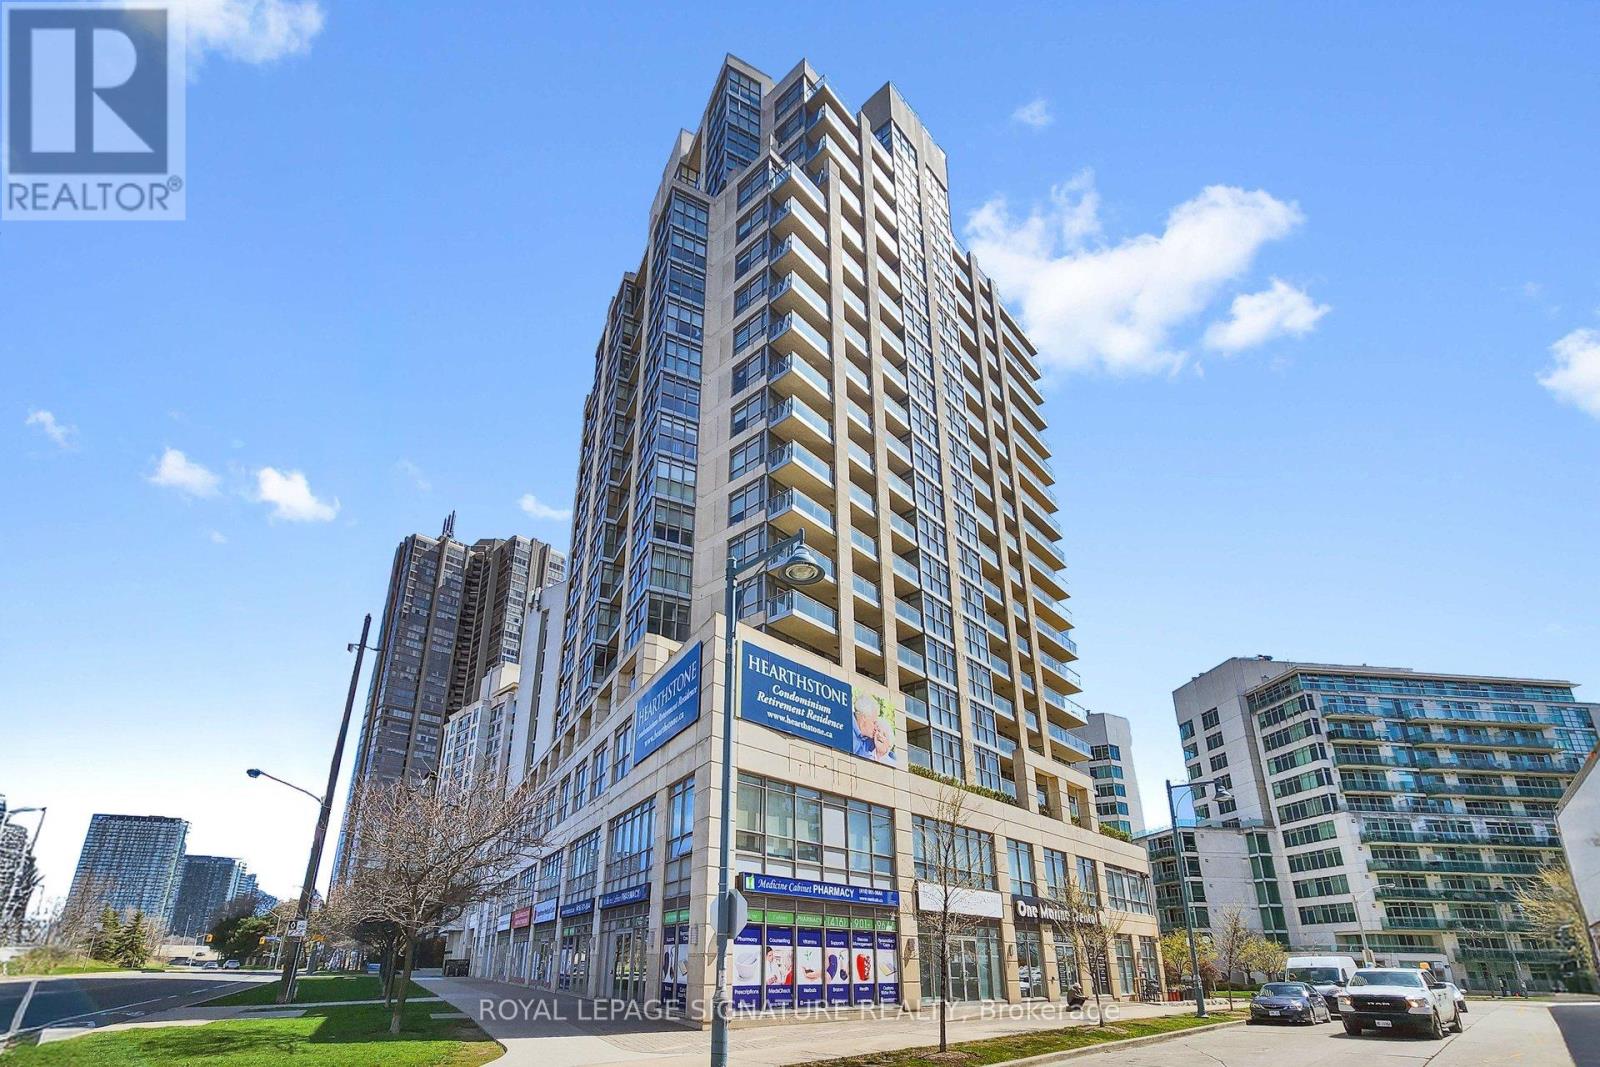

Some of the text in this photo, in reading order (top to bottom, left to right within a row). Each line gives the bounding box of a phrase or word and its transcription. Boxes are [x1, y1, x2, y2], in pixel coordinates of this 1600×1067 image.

[638, 661, 697, 727] HEARTHSTONE
[748, 654, 848, 707] HEARTHSTONE
[757, 690, 844, 731] Retirement Residence
[772, 684, 832, 715] Condominium
[766, 711, 833, 739] www.hearthstone.ca
[757, 879, 787, 891] Medicine
[788, 882, 813, 893] Cabinet
[813, 884, 855, 898] PHARMACY
[1017, 900, 1038, 918] One
